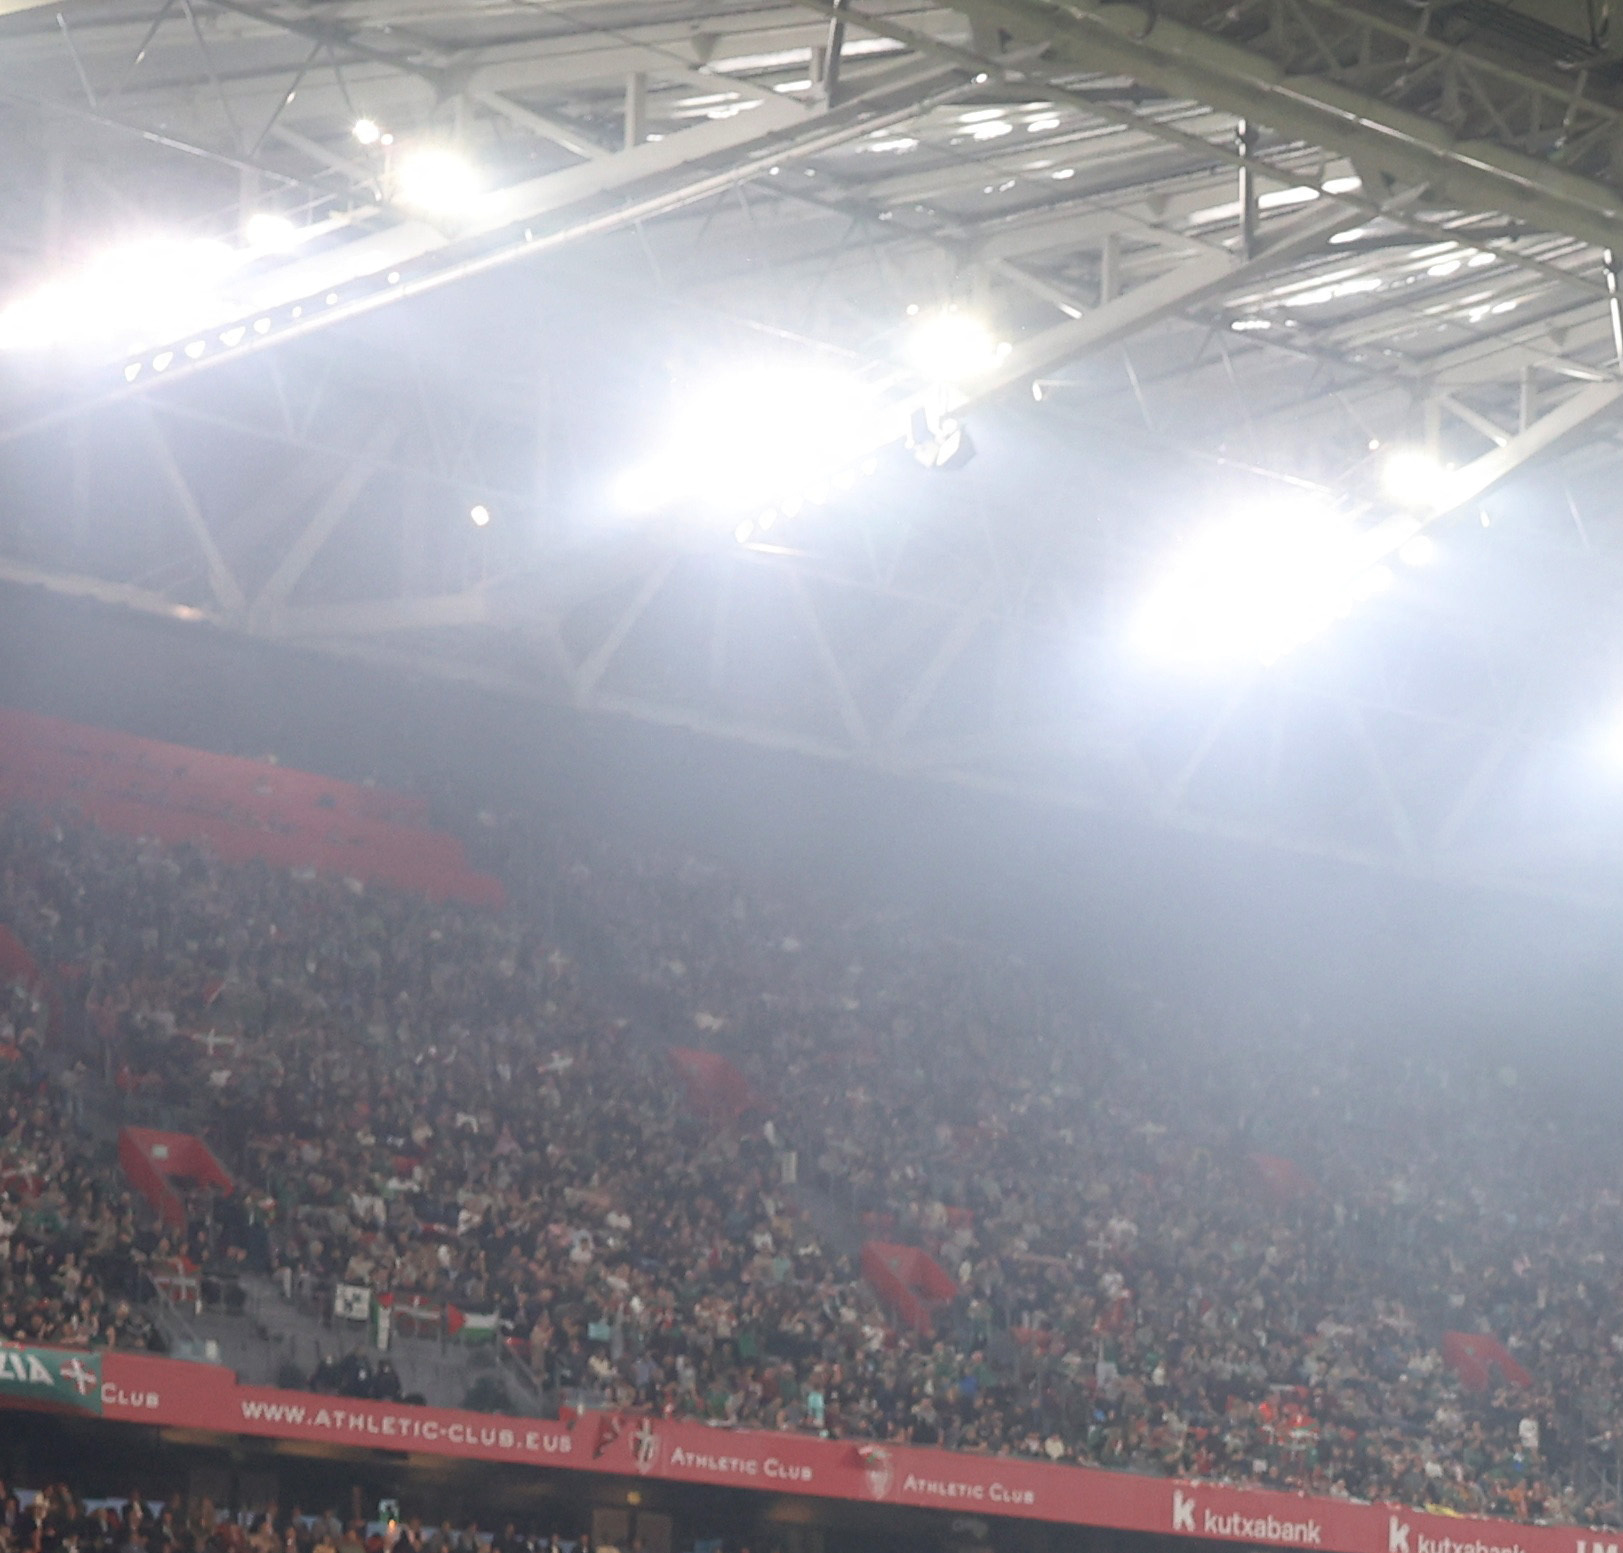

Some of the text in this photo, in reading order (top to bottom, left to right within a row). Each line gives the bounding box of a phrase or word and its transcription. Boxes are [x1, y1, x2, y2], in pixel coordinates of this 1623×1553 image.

[240, 1400, 573, 1453] WWW.ATHLETIC-CLUB.EUS
[671, 1447, 813, 1482] ATHLETIC CLUB
[903, 1474, 1036, 1505] ATHLETIC CLUB
[1204, 1507, 1322, 1545] kutxabank
